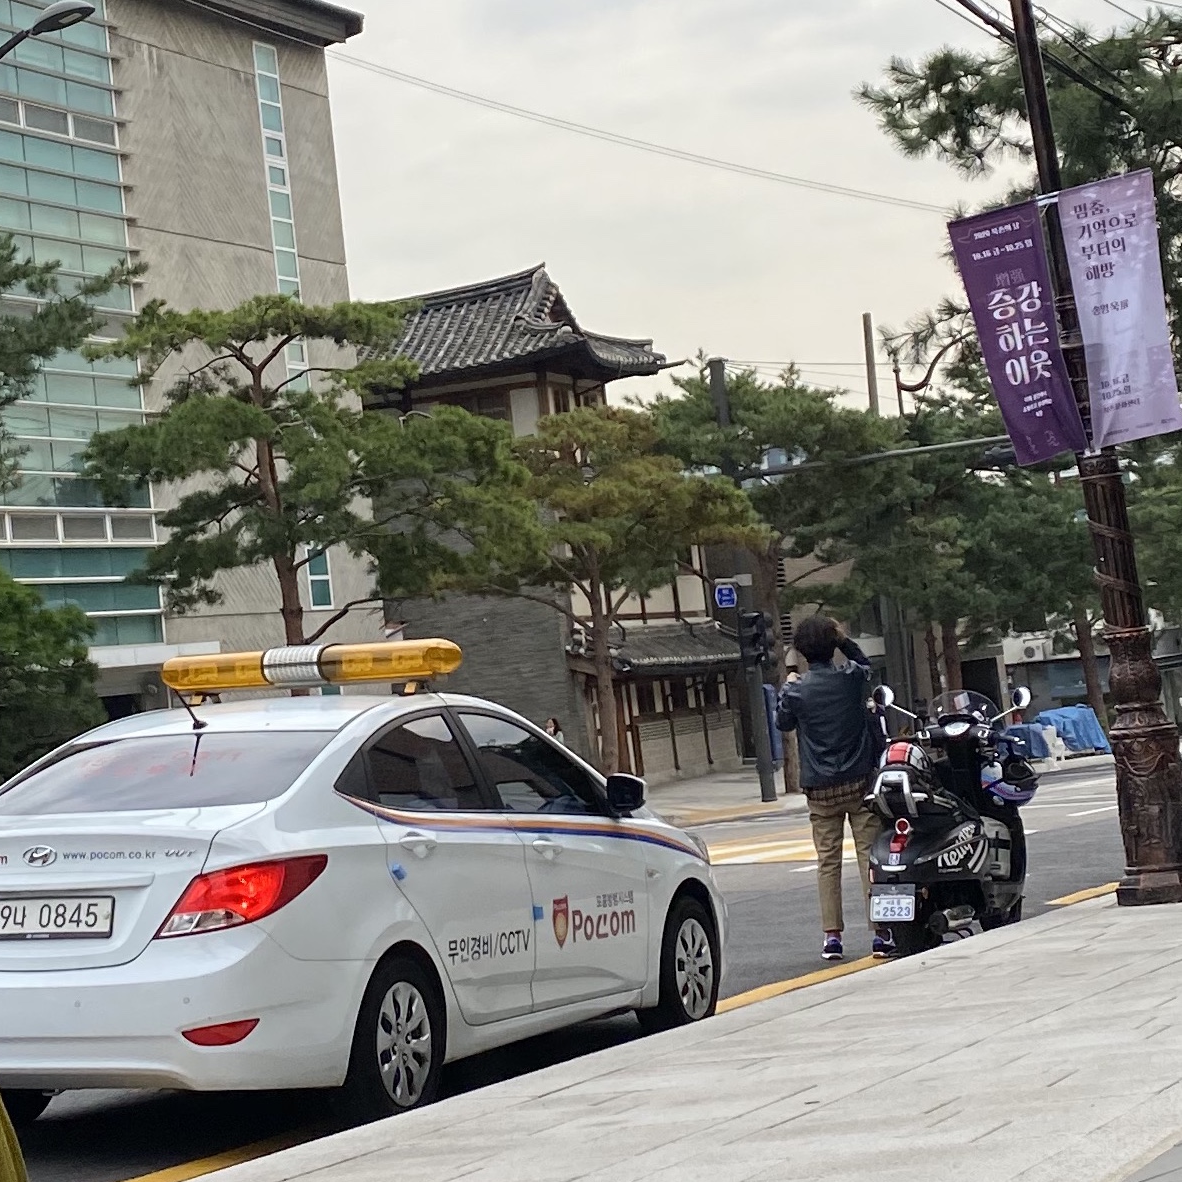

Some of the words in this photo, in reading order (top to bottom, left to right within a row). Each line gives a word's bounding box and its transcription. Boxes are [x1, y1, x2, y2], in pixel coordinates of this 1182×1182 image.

[1078, 213, 1138, 240] 기억으로
[1081, 236, 1127, 260] 부터의
[1086, 261, 1116, 281] 해방
[987, 281, 1042, 320] 증강
[995, 318, 1050, 352] 하는
[1005, 349, 1053, 386] 이웃
[62, 849, 157, 862] www.pocom.co.kr
[38, 902, 99, 929] 0845
[882, 907, 911, 917] 2523
[572, 909, 635, 943] Pocom
[448, 929, 530, 966] 무인경비/CCTV
